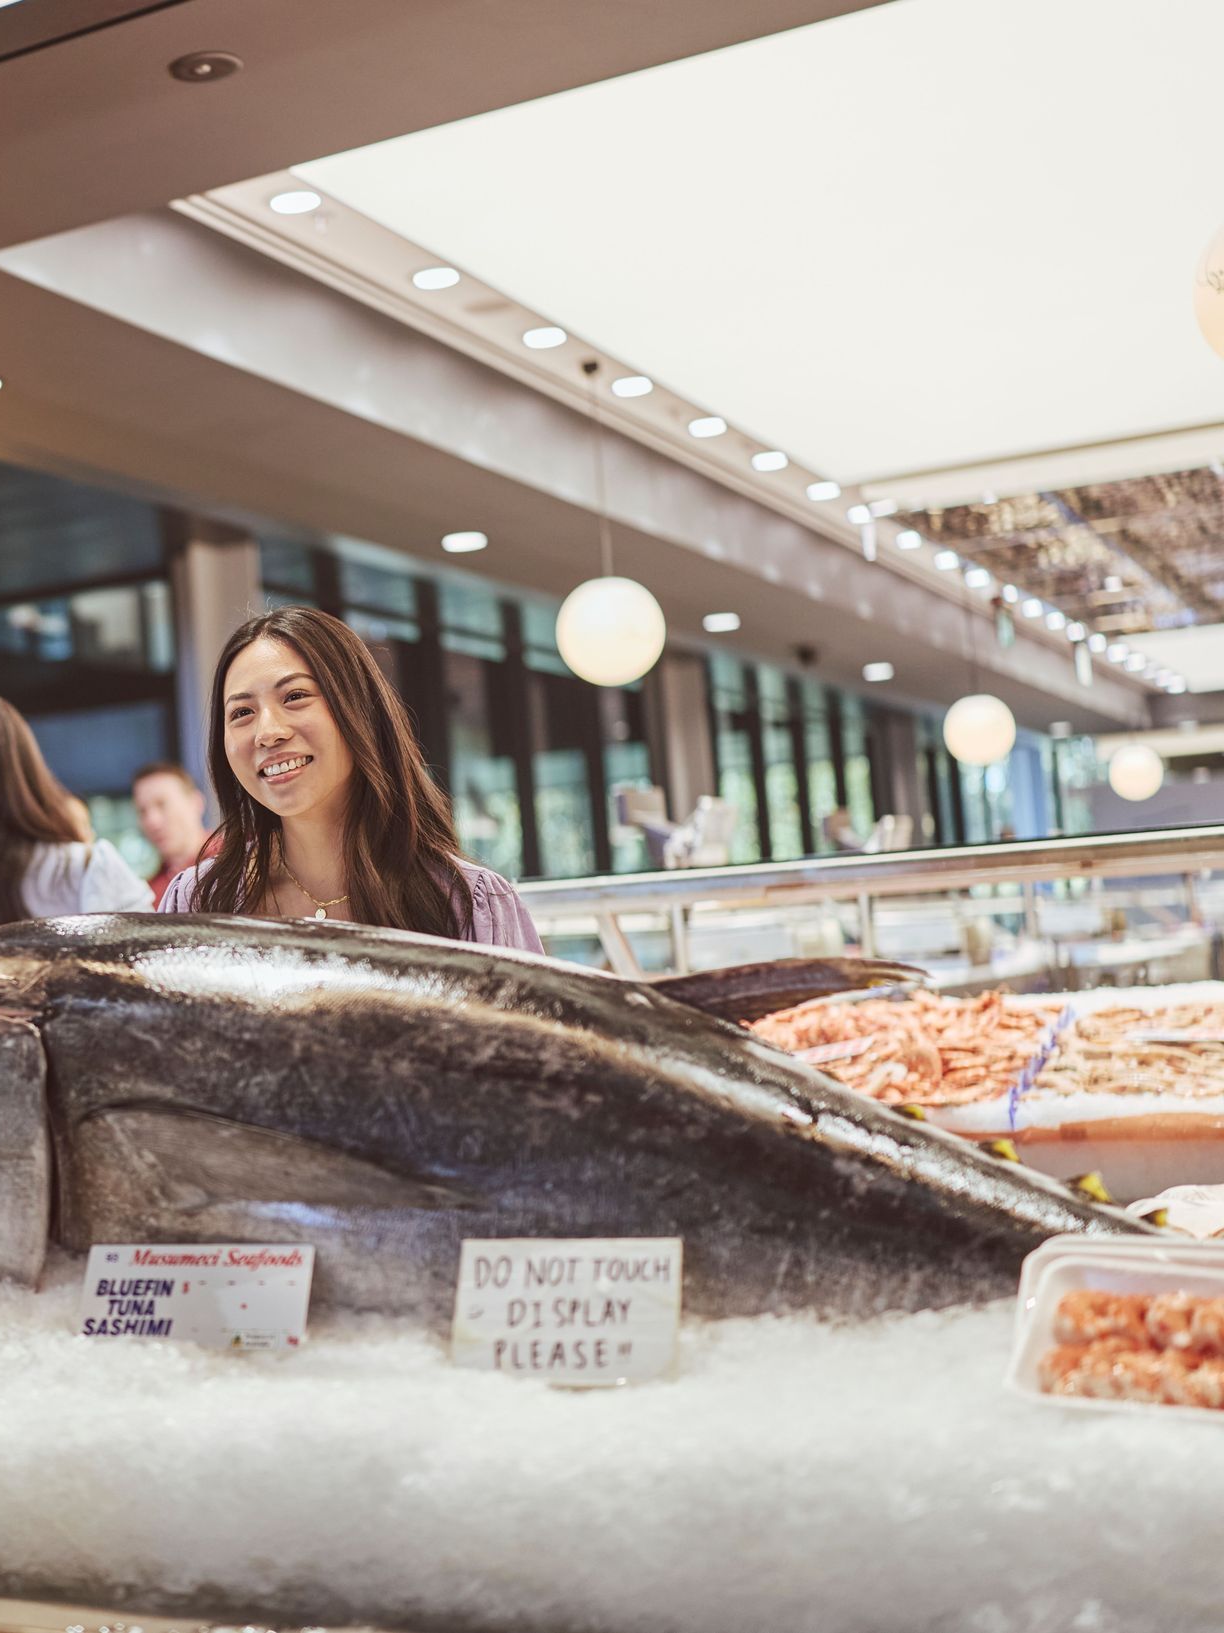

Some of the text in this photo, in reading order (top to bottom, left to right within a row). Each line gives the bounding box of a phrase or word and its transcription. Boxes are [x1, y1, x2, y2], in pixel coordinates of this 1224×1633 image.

[224, 1249, 304, 1269] Seafoods
[474, 1256, 671, 1289] DO NOT TOUCH
[96, 1278, 175, 1296] BLUEFIN
[108, 1299, 155, 1315] TUNA
[506, 1298, 632, 1328] DISPLAY
[83, 1318, 173, 1336] SASHIMI
